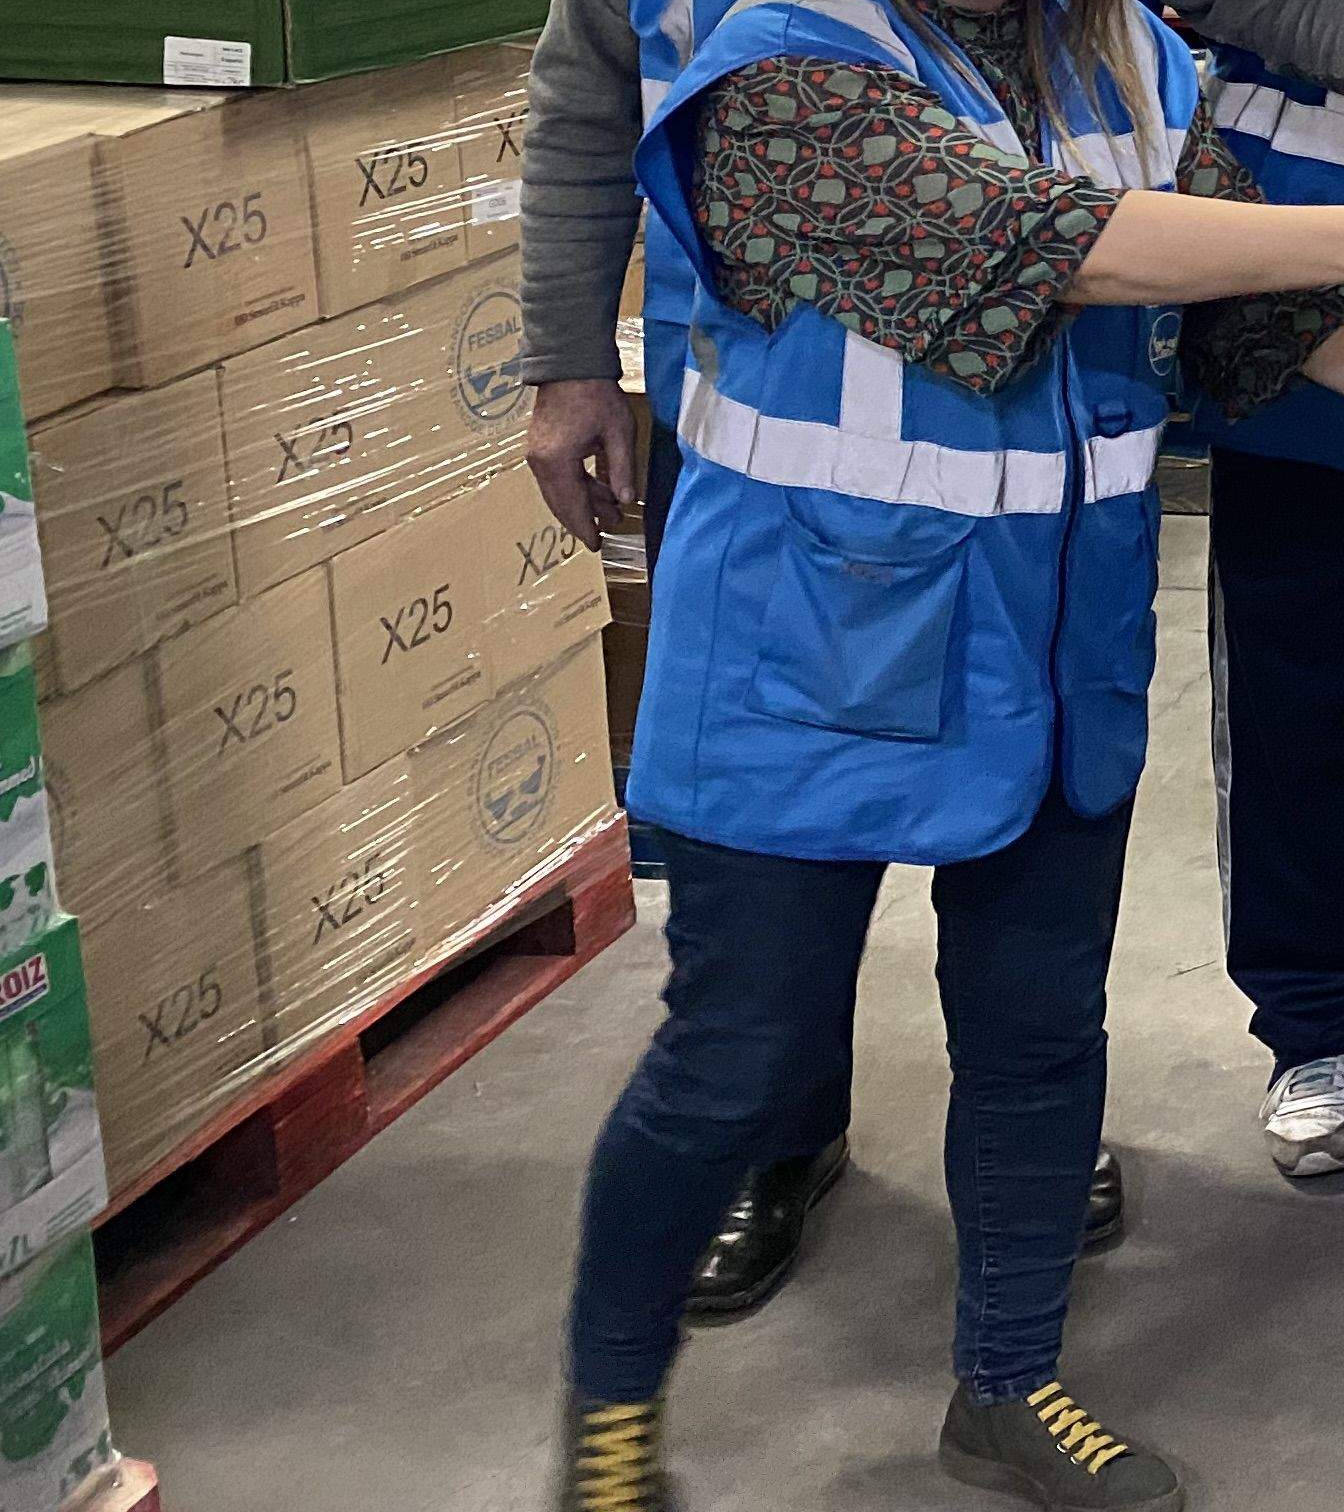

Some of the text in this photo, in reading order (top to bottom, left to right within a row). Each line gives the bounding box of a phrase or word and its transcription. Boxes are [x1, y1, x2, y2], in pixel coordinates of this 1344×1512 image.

[354, 142, 429, 207] X25
[180, 191, 267, 269] X25
[273, 409, 353, 484] X25
[97, 480, 188, 570] X25
[380, 583, 453, 666] X25
[214, 668, 298, 757] X25
[310, 852, 386, 945] X25
[138, 962, 222, 1067] X25
